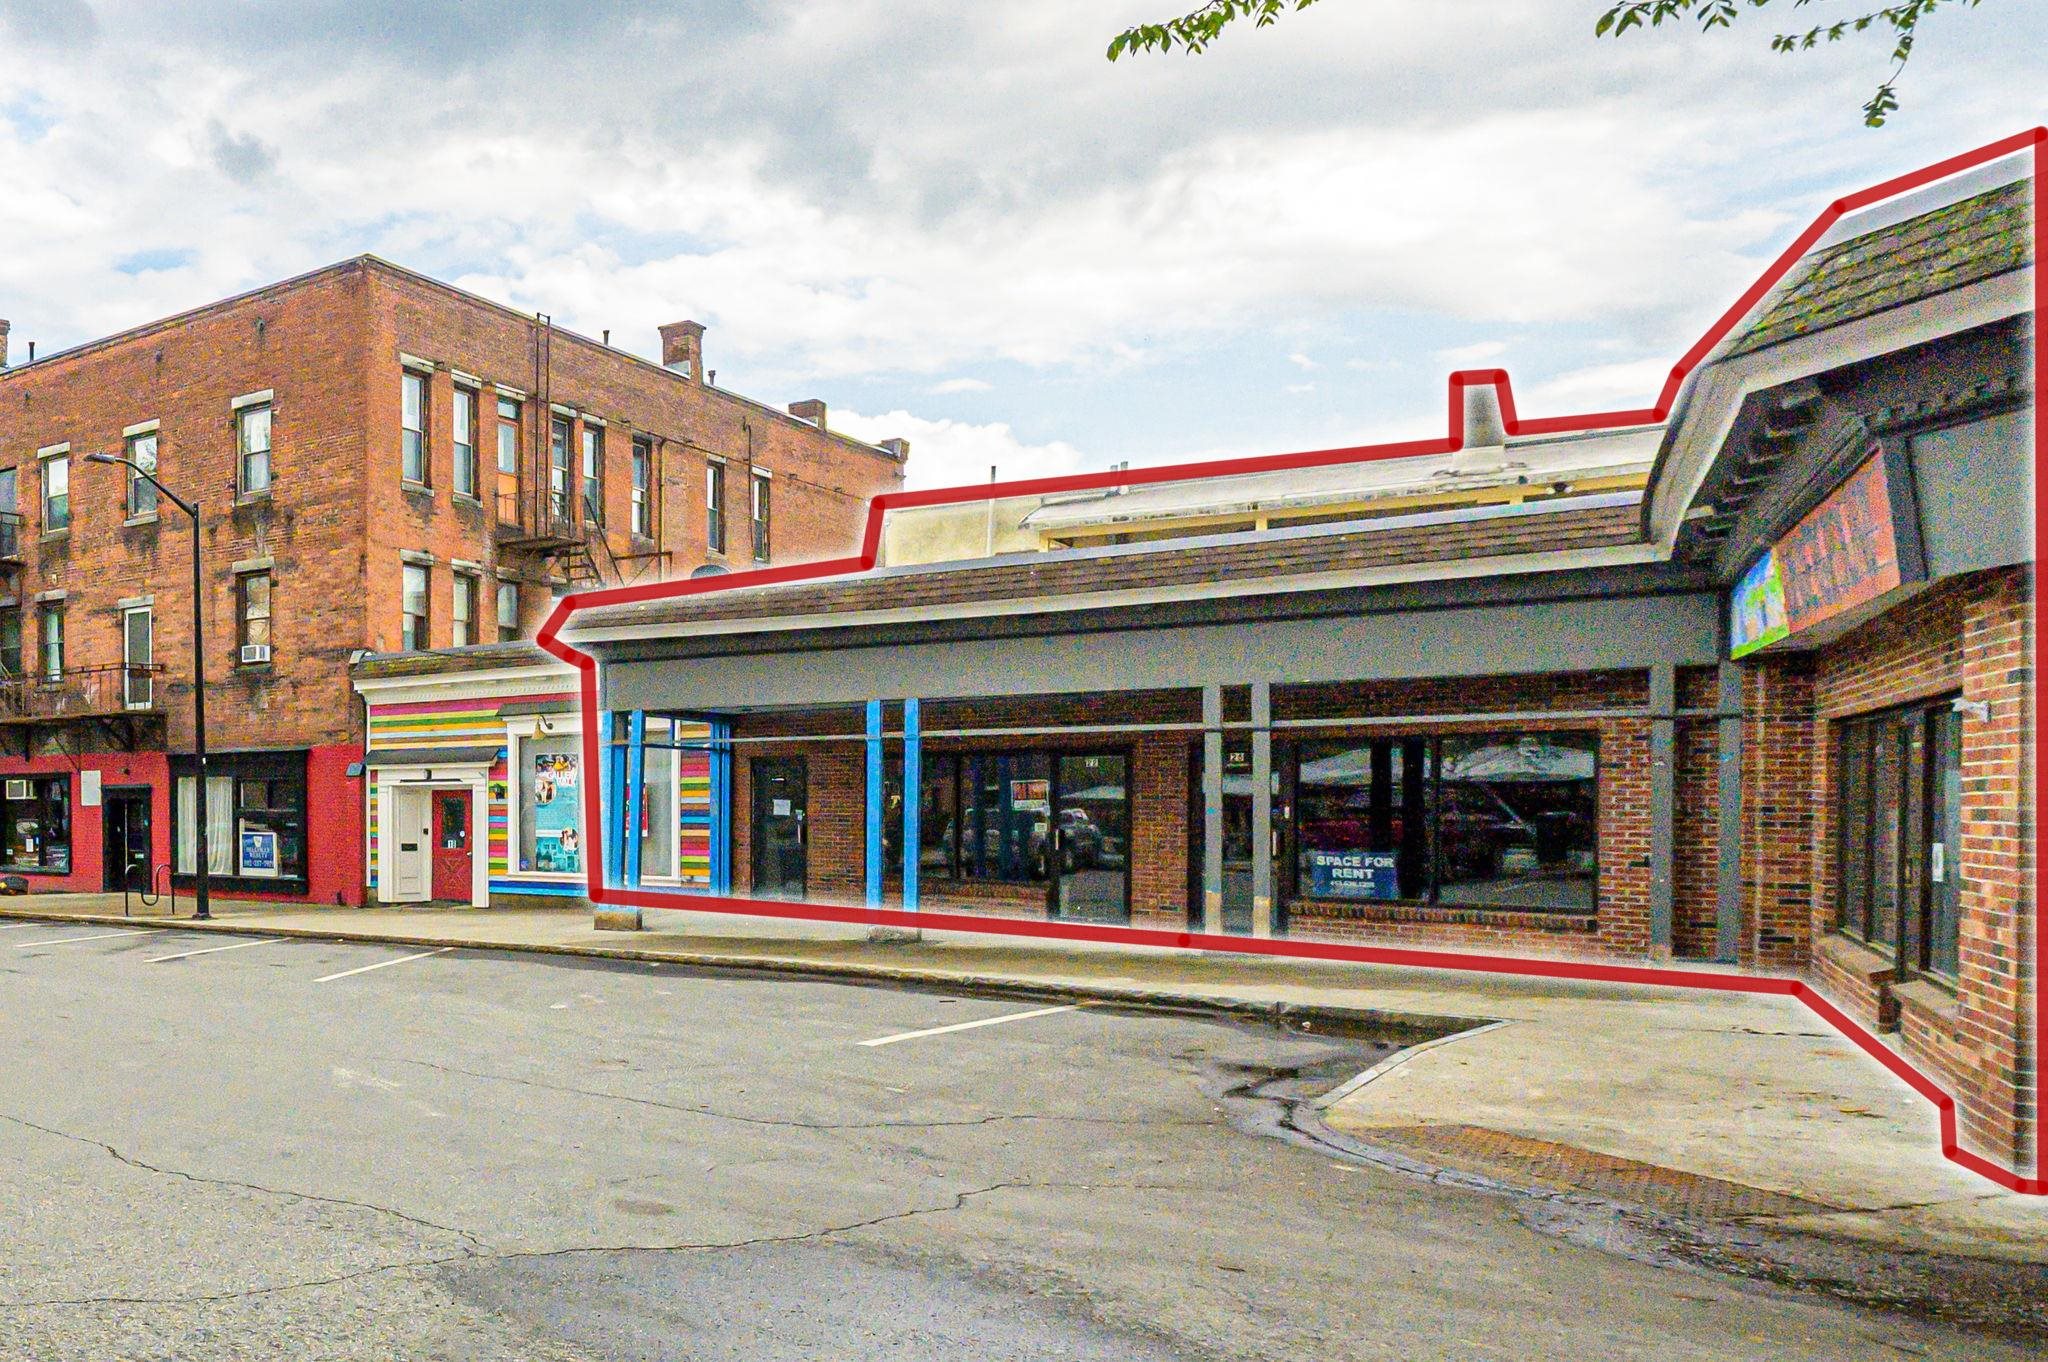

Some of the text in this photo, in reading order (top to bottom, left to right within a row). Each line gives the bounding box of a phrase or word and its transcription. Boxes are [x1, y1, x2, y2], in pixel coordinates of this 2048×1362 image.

[1316, 855, 1394, 868] SPACE FOR
[1332, 868, 1375, 879] RENT
